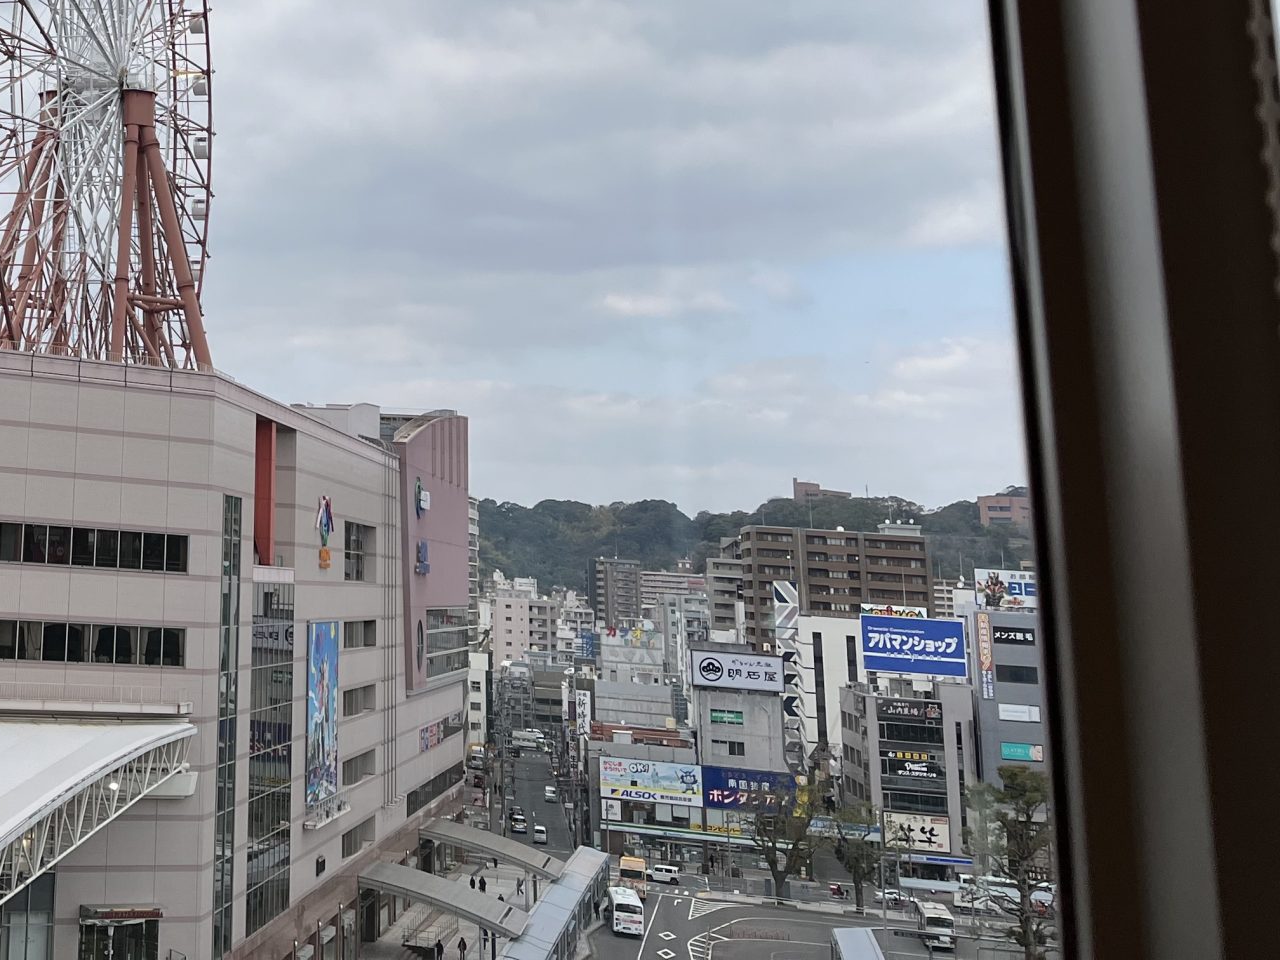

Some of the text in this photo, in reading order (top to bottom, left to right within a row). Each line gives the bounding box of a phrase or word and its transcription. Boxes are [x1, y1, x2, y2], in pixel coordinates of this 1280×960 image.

[867, 632, 958, 653] アパマンショップ
[727, 668, 778, 682] 明石屋
[629, 762, 650, 773] OK!
[620, 789, 658, 800] ALSOK
